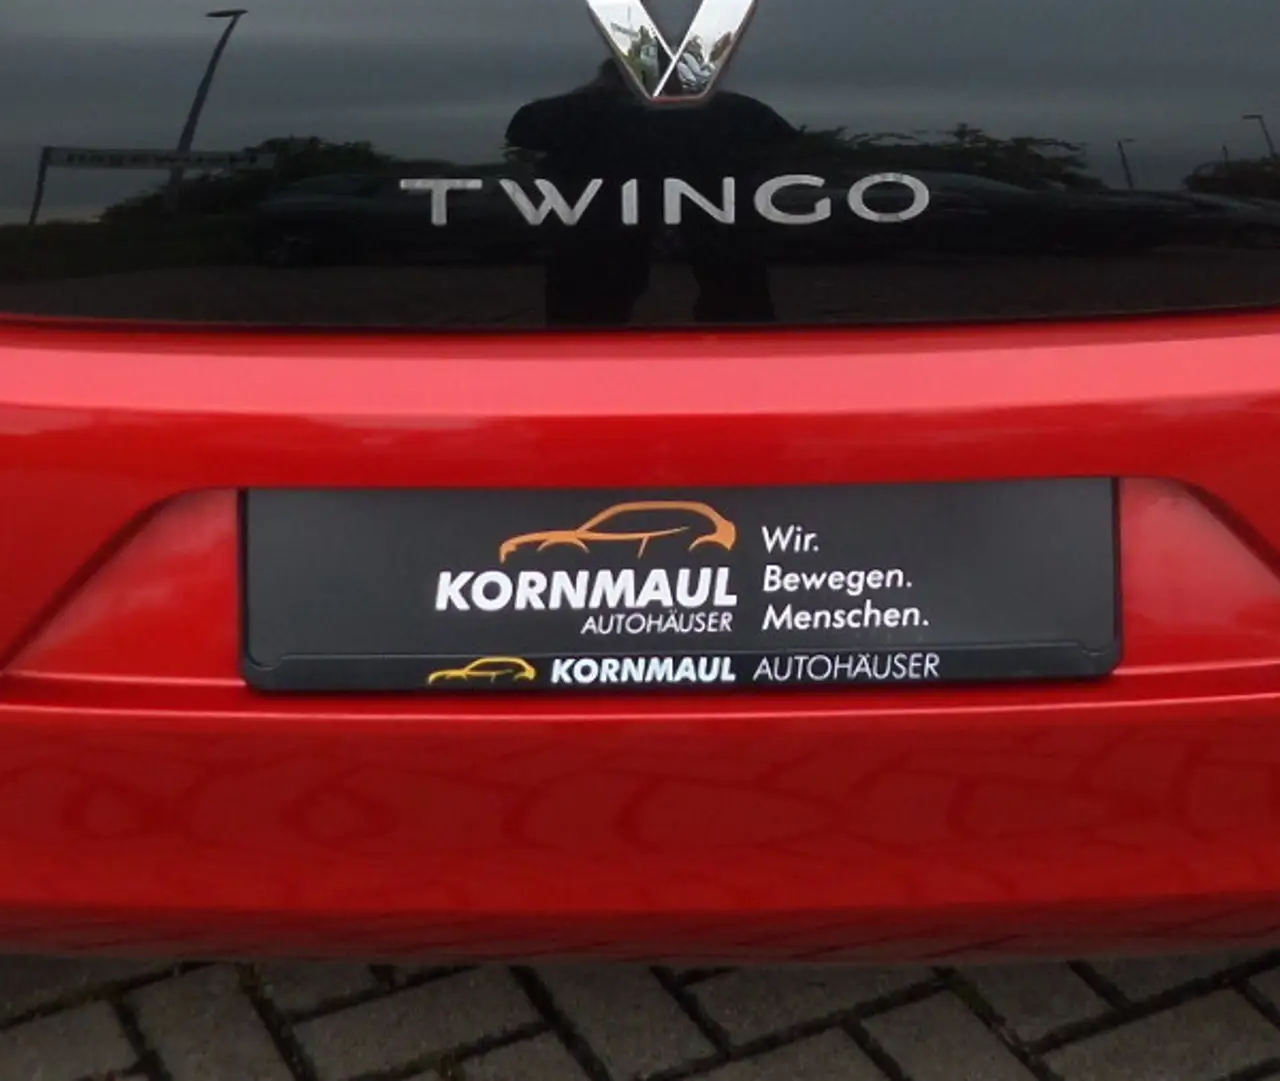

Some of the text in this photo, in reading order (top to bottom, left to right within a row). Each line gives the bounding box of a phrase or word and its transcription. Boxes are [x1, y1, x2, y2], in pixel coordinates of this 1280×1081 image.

[399, 172, 931, 226] TWINGO
[761, 524, 820, 554] Wir.
[435, 567, 738, 612] KORNMAUL
[762, 564, 913, 596] Bewegen.
[580, 609, 733, 636] AUTOHÄUSER
[761, 599, 930, 631] Menschen.
[551, 652, 940, 684] KORNMAUL AUTOHÄUSER
